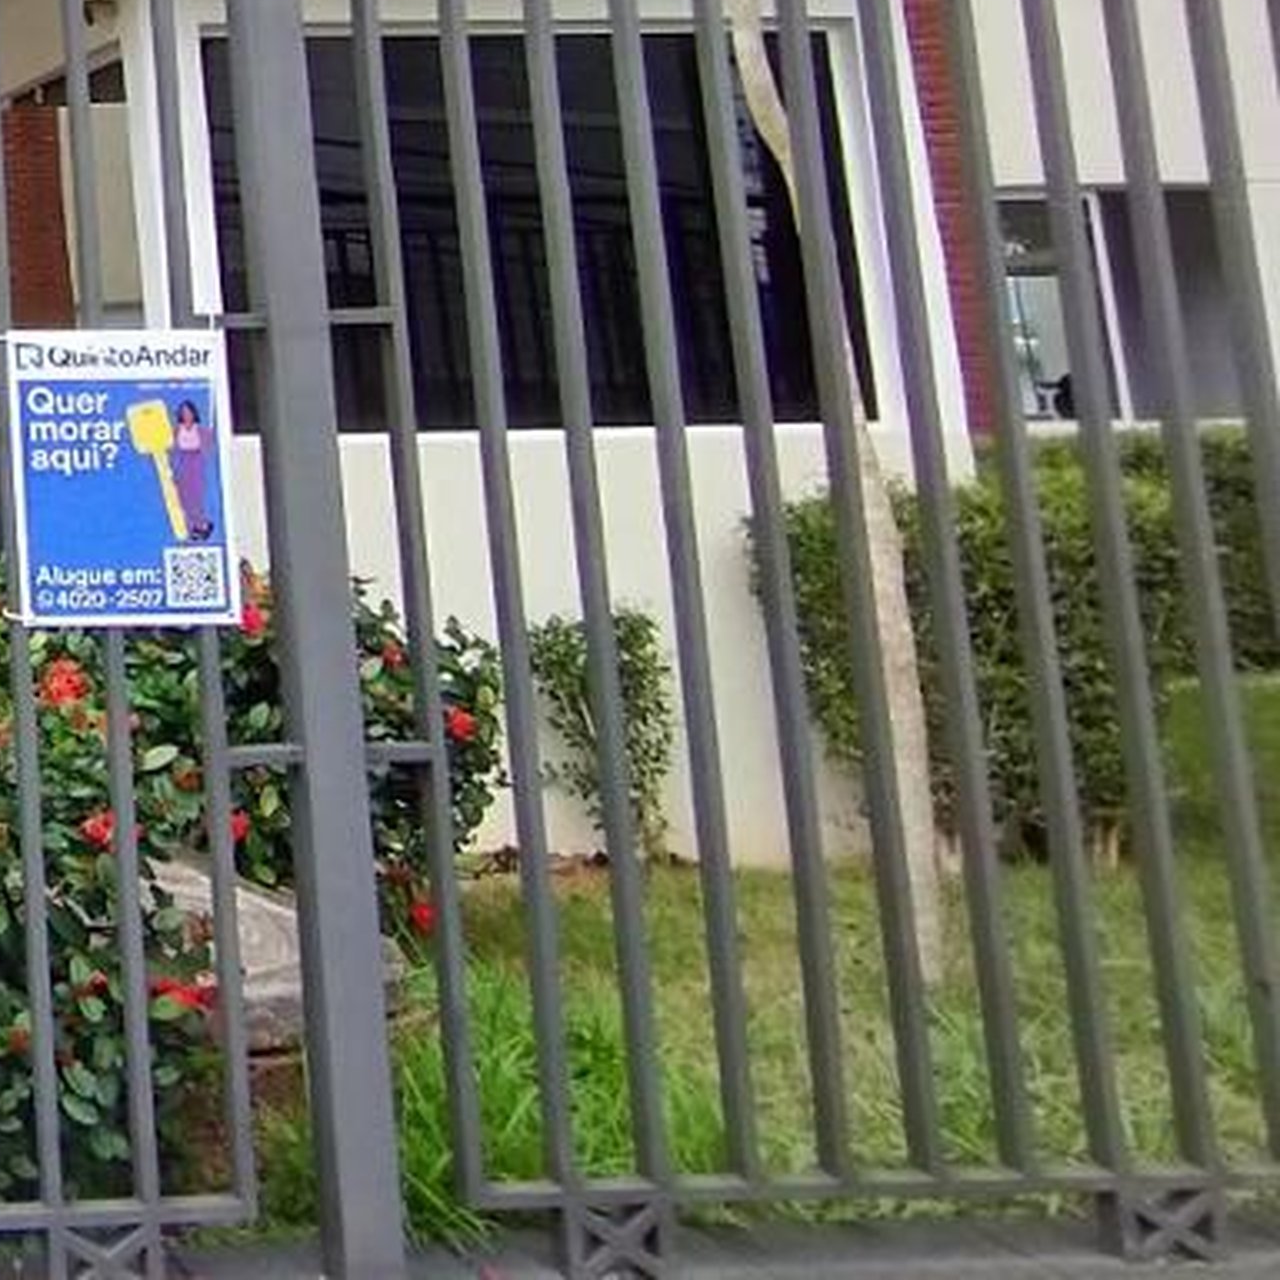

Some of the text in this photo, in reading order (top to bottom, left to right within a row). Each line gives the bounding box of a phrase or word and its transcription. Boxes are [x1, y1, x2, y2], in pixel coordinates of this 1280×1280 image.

[26, 386, 108, 415] Quer
[29, 420, 125, 442] morar
[31, 443, 119, 475] aqui?
[121, 567, 162, 585] em:
